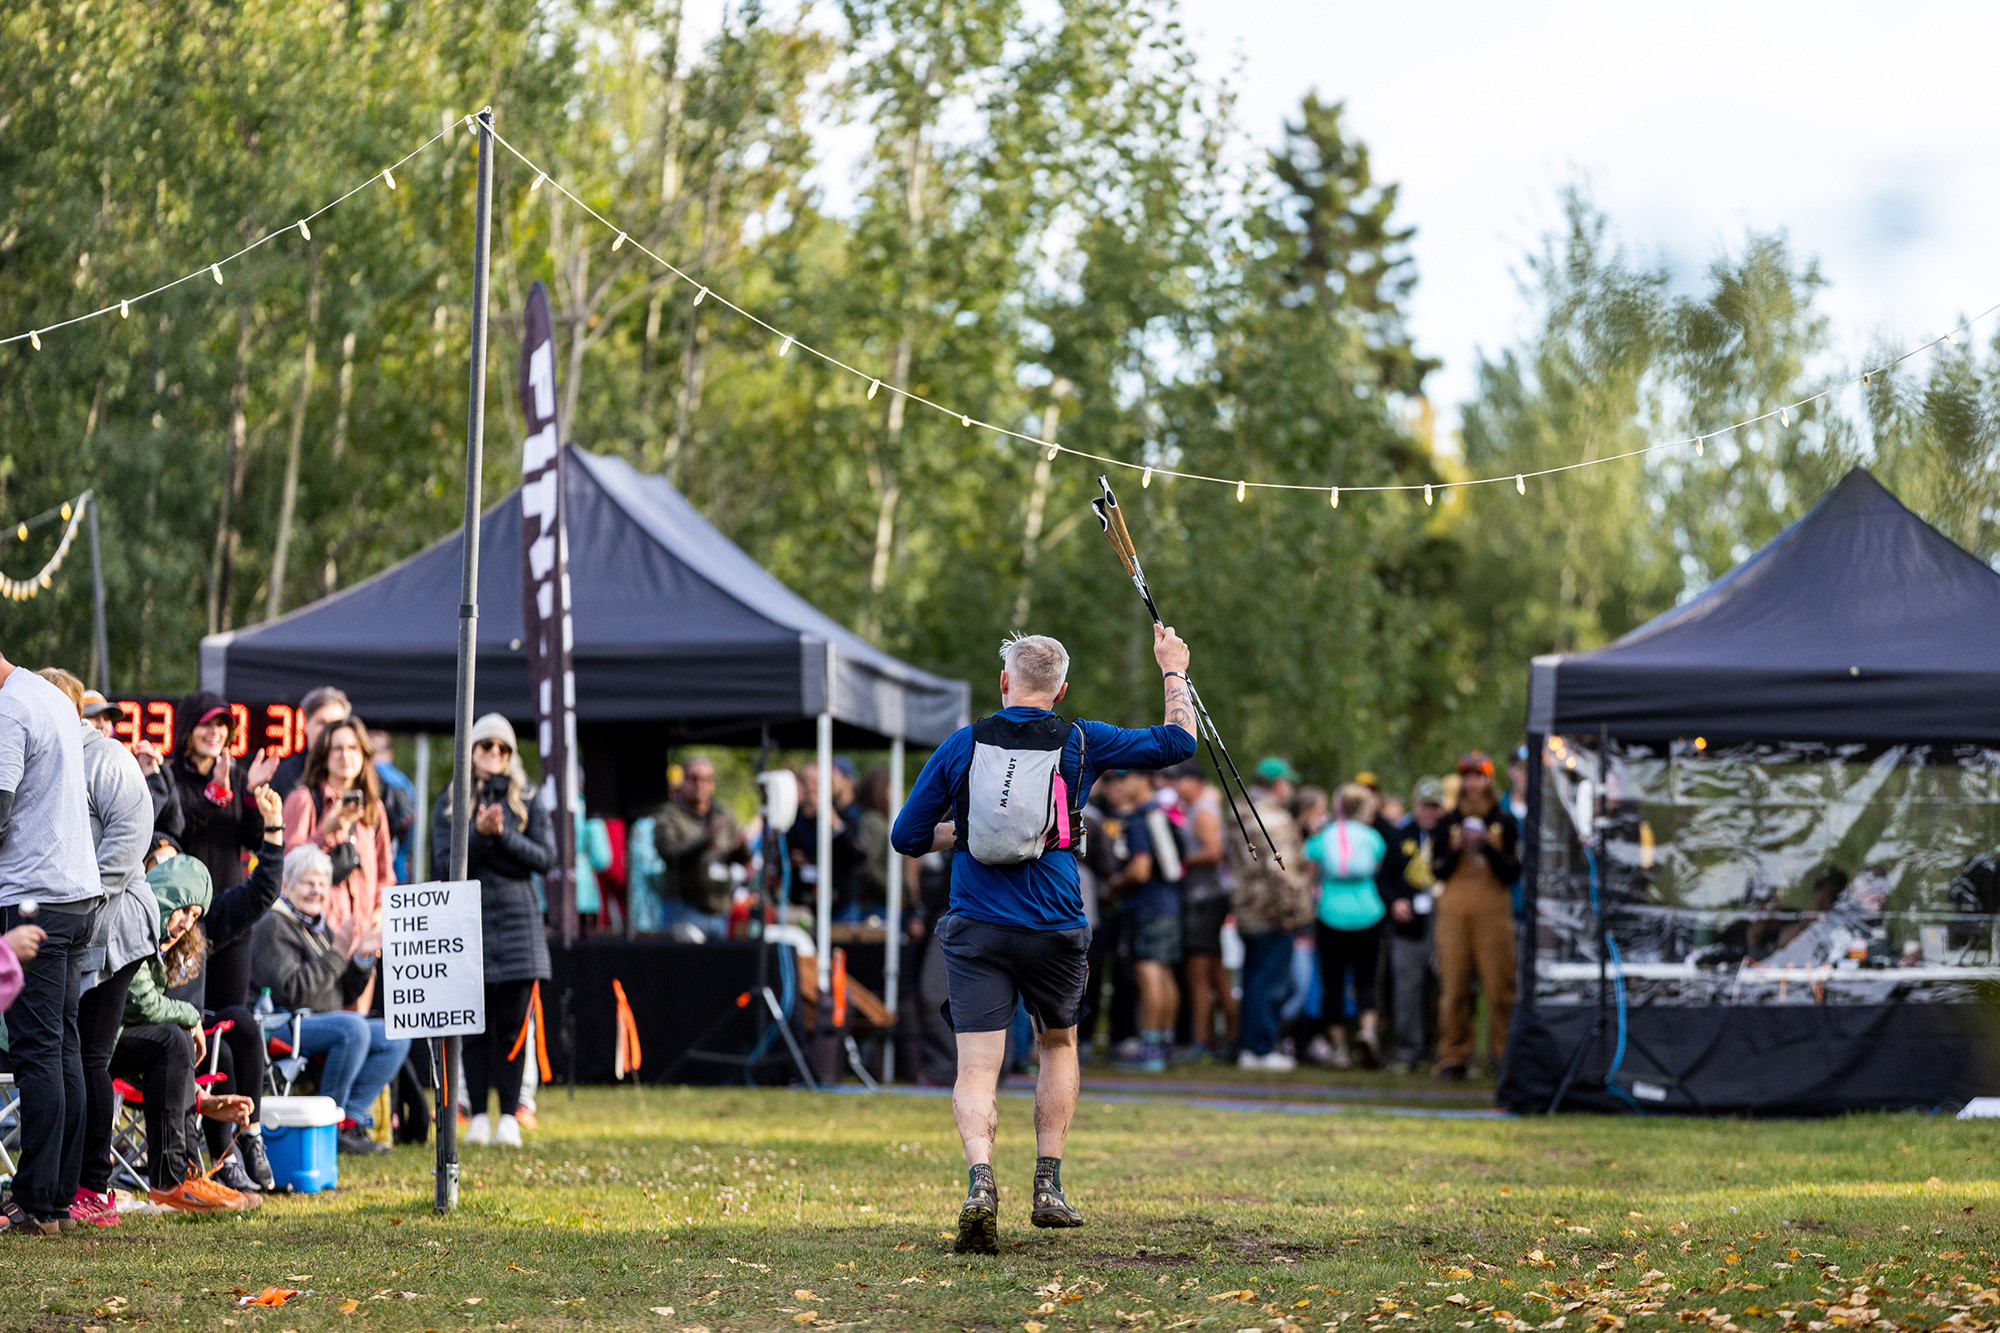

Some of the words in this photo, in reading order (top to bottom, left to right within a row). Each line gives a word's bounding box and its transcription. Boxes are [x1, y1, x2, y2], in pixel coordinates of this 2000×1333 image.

[1000, 757, 1017, 808] MAMMUT
[390, 890, 450, 909] SHOW
[390, 915, 429, 932] THE
[390, 937, 464, 956] TIMERS
[392, 962, 448, 980] YOUR
[393, 988, 425, 1004] BIB
[393, 1009, 476, 1029] NUMBER
